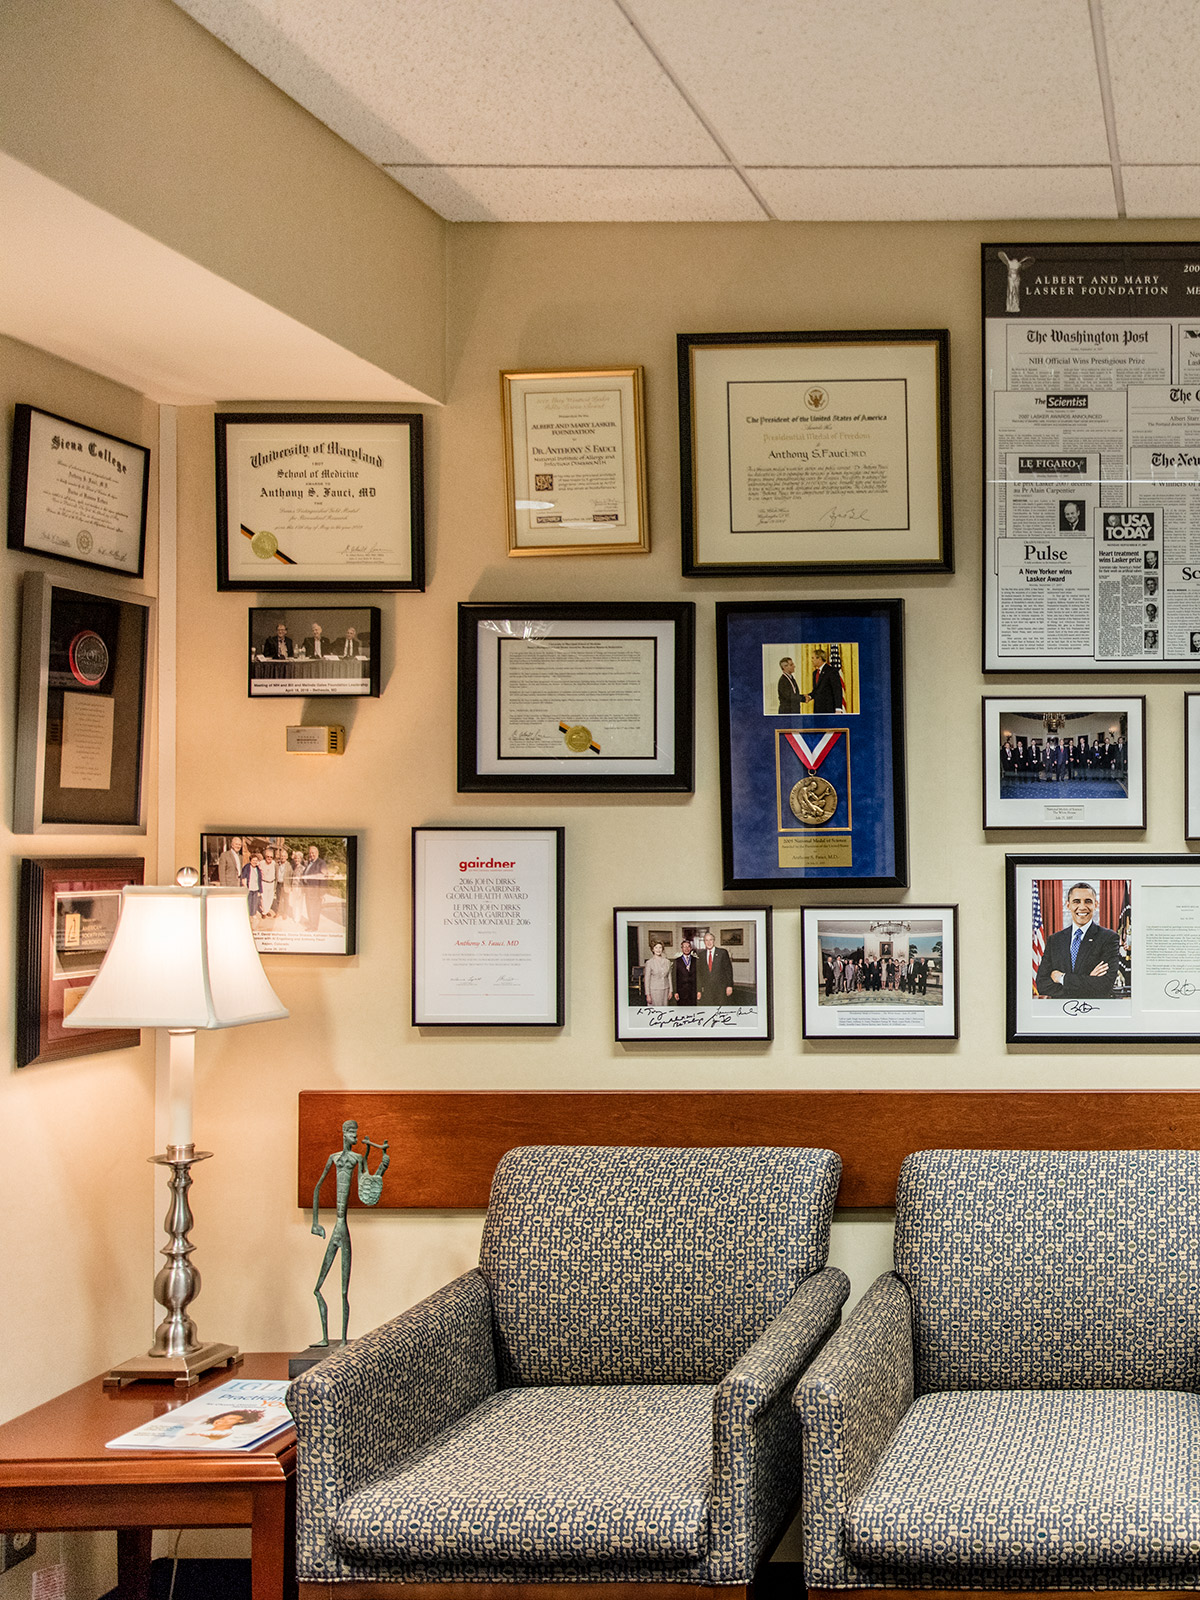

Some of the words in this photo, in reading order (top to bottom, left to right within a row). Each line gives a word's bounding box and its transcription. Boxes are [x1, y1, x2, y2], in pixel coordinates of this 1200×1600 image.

[1035, 276, 1084, 284] ALBERT
[1091, 276, 1118, 284] AND
[1124, 275, 1160, 284] MARY
[1026, 286, 1075, 295] LASKER
[1082, 286, 1169, 295] FOUNDATION
[1027, 329, 1048, 344] The
[1050, 329, 1119, 345] Washington
[1123, 329, 1149, 346] Post
[1091, 357, 1127, 366] Prestigious
[1048, 396, 1087, 407] Scientist
[1170, 388, 1193, 404] The
[760, 416, 789, 425] President
[51, 435, 83, 452] Siena
[88, 442, 127, 474] College
[250, 444, 309, 468] University
[313, 443, 326, 453] of
[327, 442, 383, 467] Maryland
[768, 450, 809, 462] Anthony
[1151, 453, 1176, 467] The
[1020, 460, 1034, 468] LE
[1036, 459, 1075, 468] FIGARO
[277, 469, 307, 479] School
[310, 470, 319, 478] of
[321, 469, 359, 478] Medicine
[260, 488, 303, 499] Anthony
[308, 488, 319, 497] S.
[323, 488, 354, 498] Fauci,
[359, 488, 377, 497] MD
[1121, 515, 1150, 527] USA
[1106, 527, 1151, 539] TODAY
[1024, 544, 1068, 560] Pulse
[459, 857, 516, 872] gairdner
